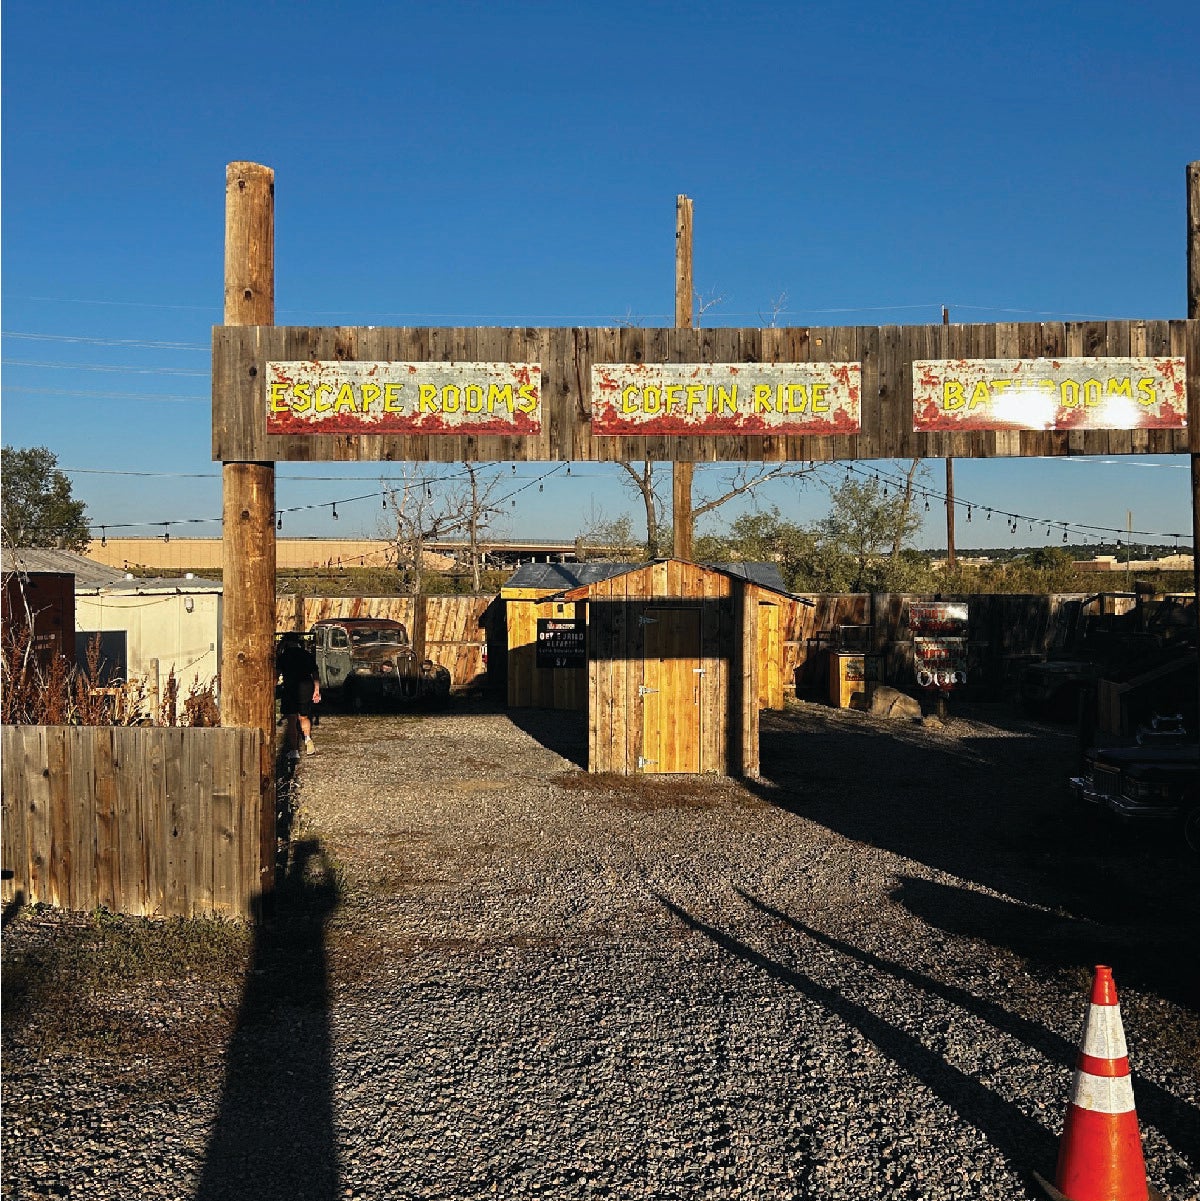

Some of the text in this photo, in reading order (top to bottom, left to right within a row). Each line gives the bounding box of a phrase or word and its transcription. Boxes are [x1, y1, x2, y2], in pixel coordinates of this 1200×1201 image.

[270, 382, 538, 414] ESCAPE ROOMS
[621, 383, 831, 414] COFFIN RIDE
[943, 377, 1157, 411] BATOOMS
